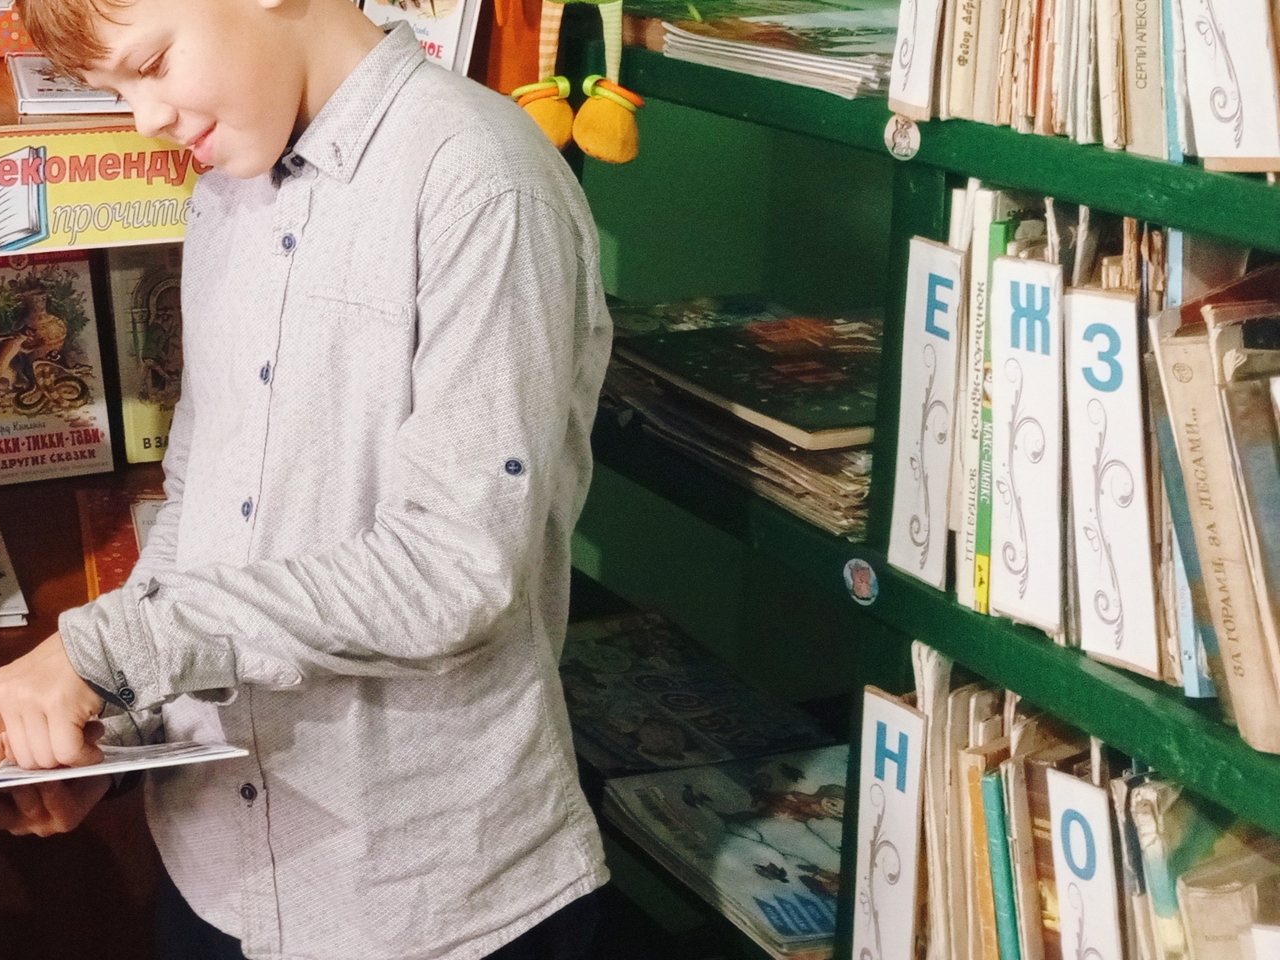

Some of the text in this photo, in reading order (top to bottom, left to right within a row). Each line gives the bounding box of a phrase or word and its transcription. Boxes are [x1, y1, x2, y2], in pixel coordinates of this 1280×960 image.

[957, 31, 973, 66] Федор
[1135, 44, 1147, 89] СЕРГІЙ
[925, 273, 954, 341] Е
[1009, 281, 1051, 356] Ж
[1082, 323, 1124, 392] З
[1, 453, 46, 470] ДРУГИЕ
[980, 421, 994, 505] МАКС-ШМЯКС
[874, 721, 908, 793] Н
[1061, 809, 1097, 881] О
